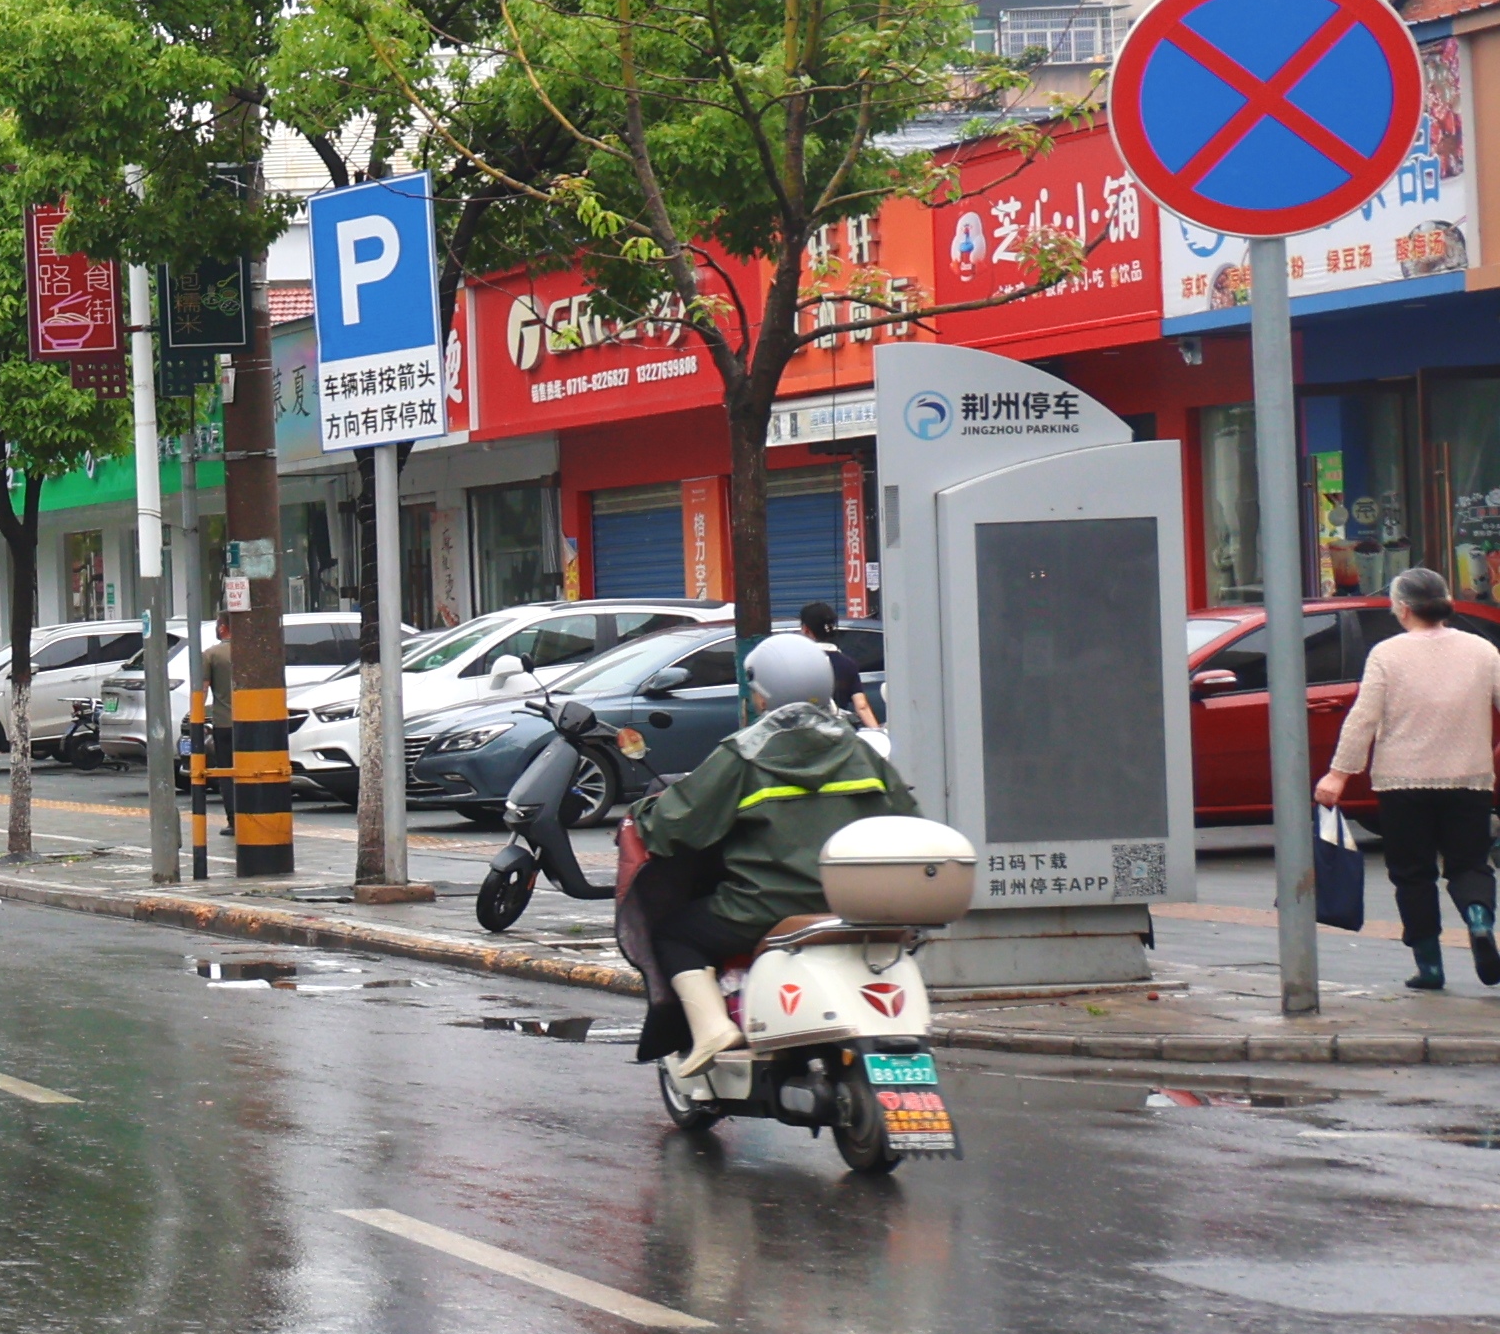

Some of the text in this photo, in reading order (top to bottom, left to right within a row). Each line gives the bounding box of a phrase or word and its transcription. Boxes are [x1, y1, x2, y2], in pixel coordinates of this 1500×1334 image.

[38, 205, 72, 296] 星路
[1326, 244, 1373, 273] 绿豆汤
[1395, 230, 1447, 262] 酸梅汤
[336, 214, 400, 326] P
[1118, 260, 1143, 284] 饮品
[323, 360, 436, 402] 车辆请按箭头
[325, 398, 438, 440] 方向有序停放
[961, 391, 1080, 421] 荆州停车
[961, 424, 1080, 435] JINGZHOU PARKING
[988, 852, 1068, 872] 扫码下载
[989, 876, 1109, 897] 荆州停车APP
